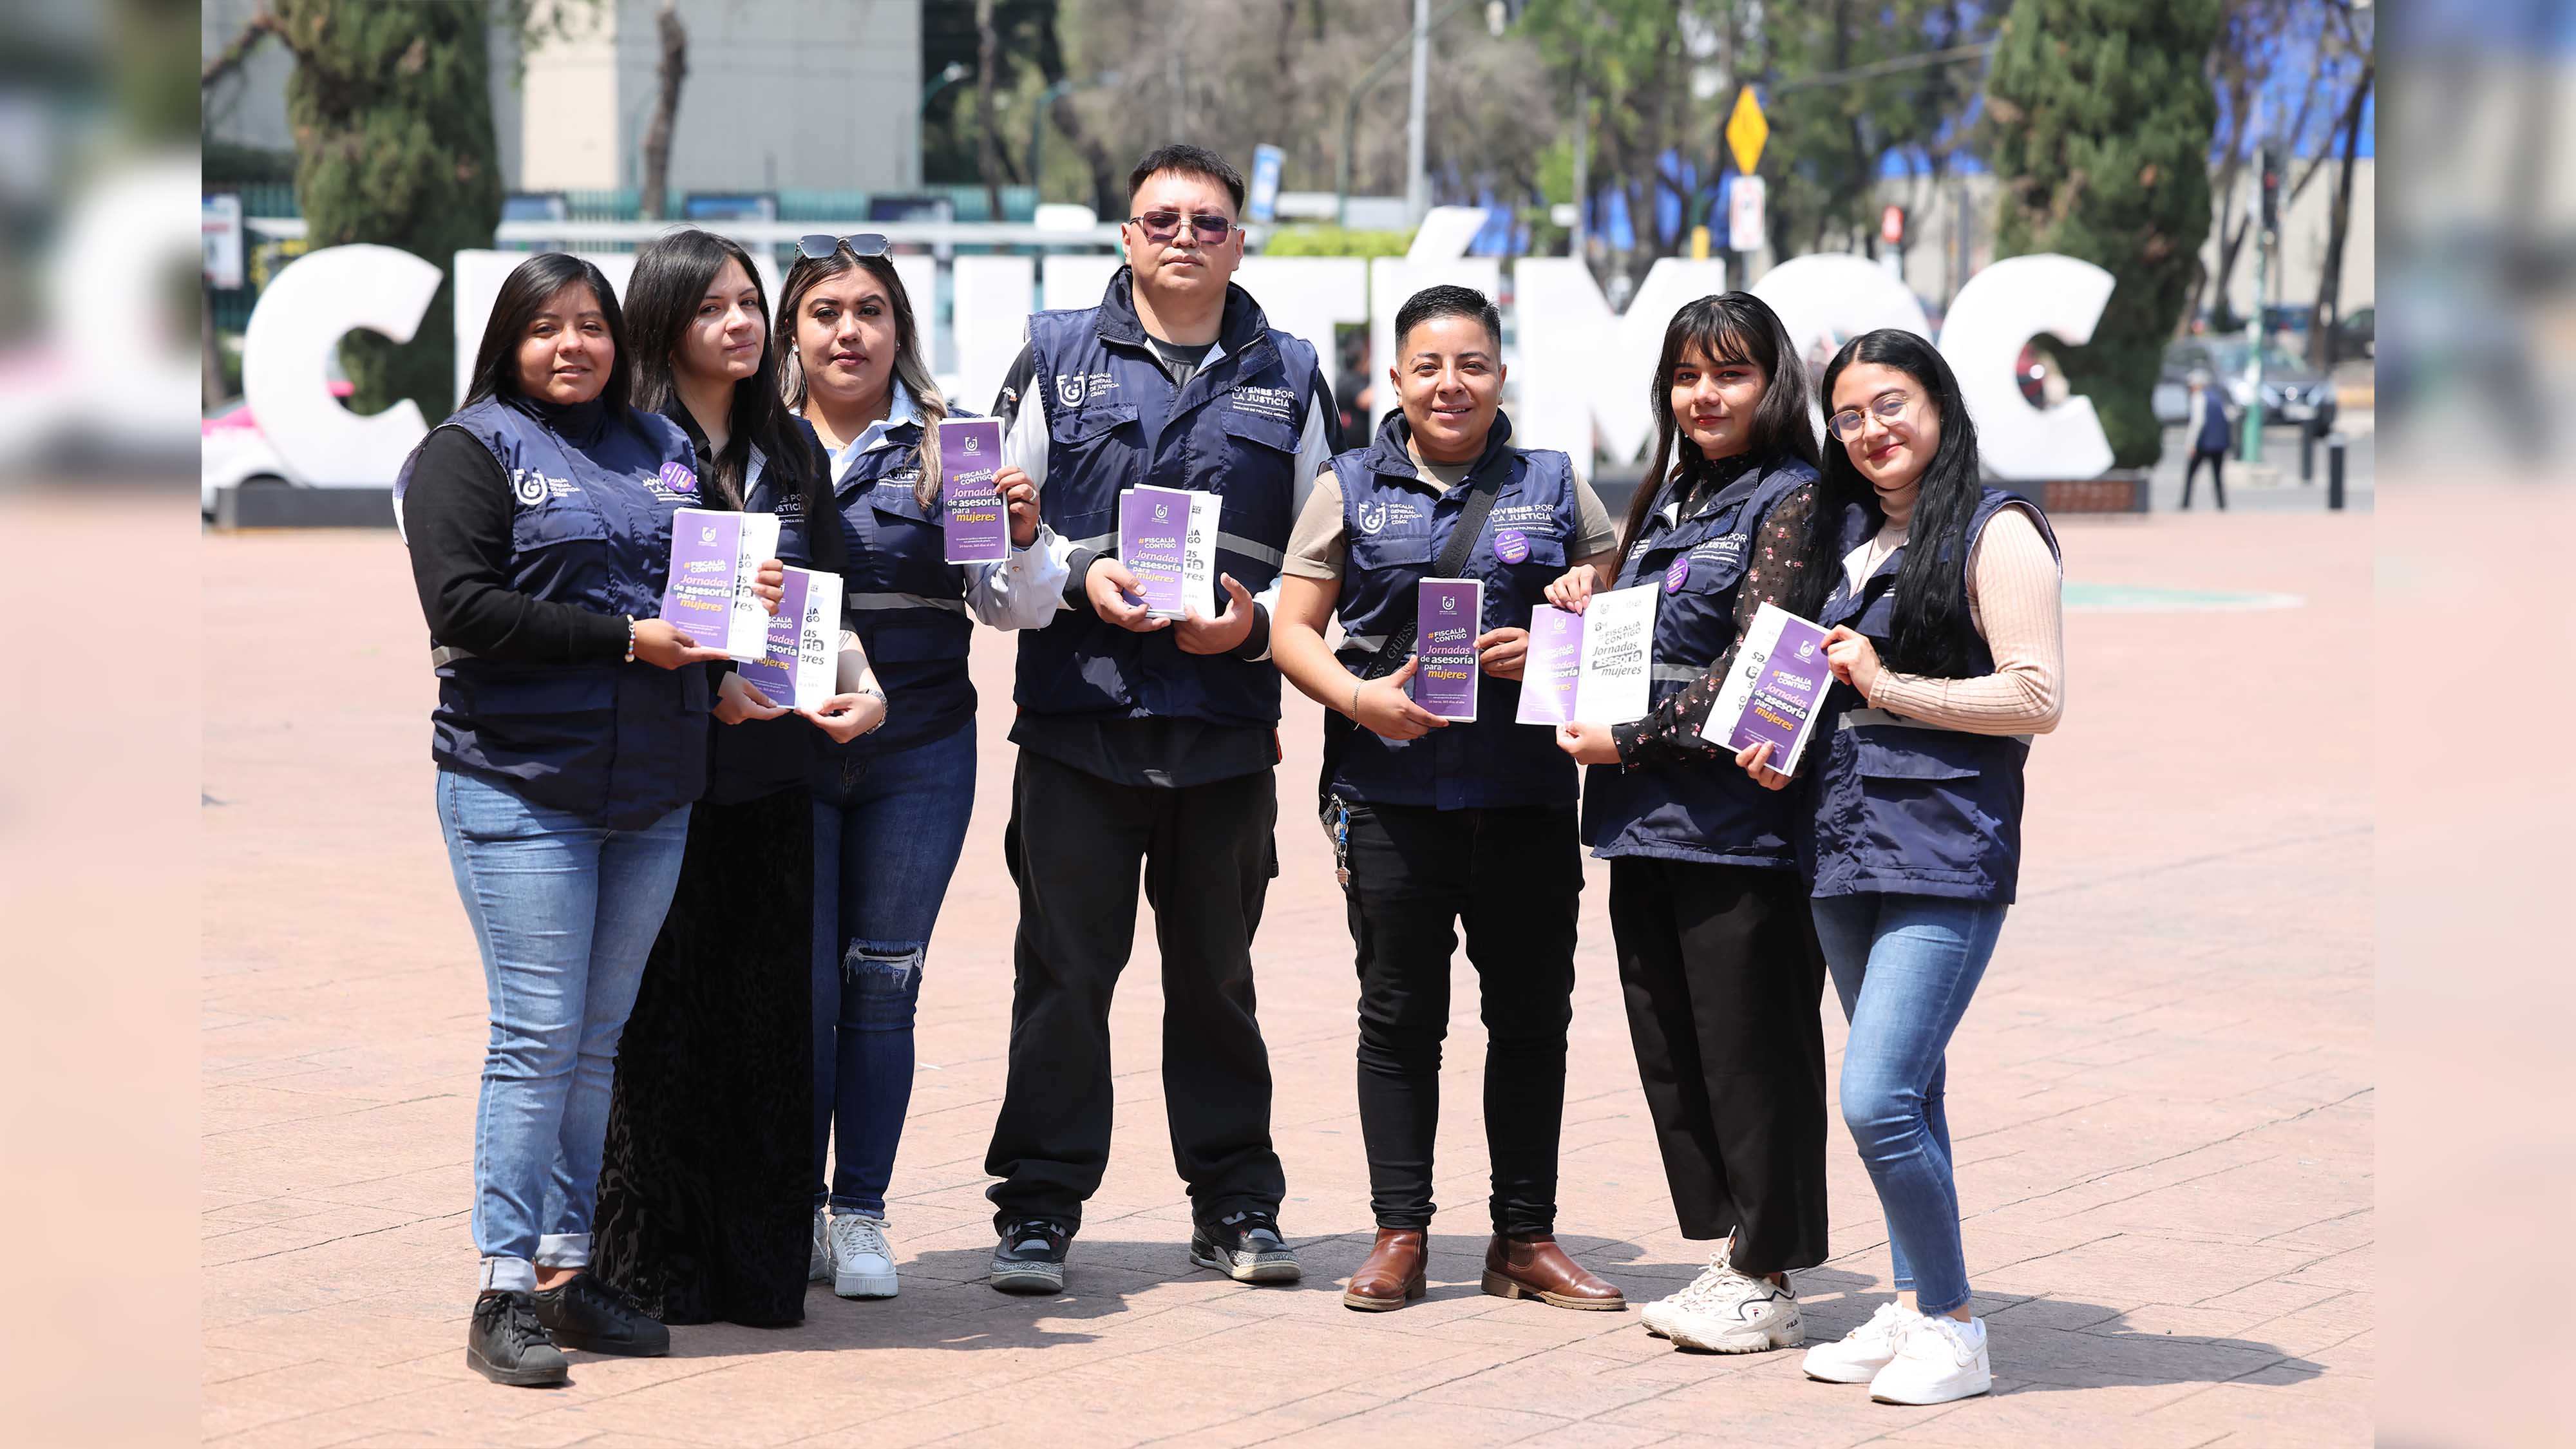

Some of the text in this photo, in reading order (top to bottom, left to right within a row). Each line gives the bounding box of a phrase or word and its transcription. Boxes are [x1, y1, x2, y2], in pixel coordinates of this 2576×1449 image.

[1274, 389, 1294, 399] POR
[1247, 394, 1289, 408] JUSTICIA
[953, 468, 991, 482] #FISCALÍA
[960, 474, 992, 486] CONTIGO
[953, 487, 997, 497] Jornadas
[958, 497, 1001, 507] asesoría
[956, 511, 996, 524] mujeres
[1508, 513, 1552, 521] JUSTICIA
[1728, 533, 1747, 542] POR
[1135, 550, 1179, 563] Jornadas
[683, 559, 726, 569] #FISCALÍA
[690, 565, 726, 573] CONTIGO
[1141, 560, 1182, 573] asesoría
[680, 574, 729, 587] Jornadas
[1136, 573, 1175, 583] mujeres
[685, 585, 732, 598] asesoría
[680, 599, 723, 612] mujeres
[1428, 627, 1466, 639] #FISCALÍA
[1435, 633, 1467, 643] CONTIGO
[1605, 627, 1642, 645] CONTIGO
[766, 645, 797, 656] esoría
[1426, 645, 1471, 654] Jornadas
[1592, 641, 1638, 656] Jornadas
[1431, 655, 1473, 665] asesoría
[1428, 669, 1468, 680] mujeres
[1601, 665, 1642, 677] mujeres
[1772, 670, 1812, 685] #FISCALÍA
[1777, 677, 1812, 692] CONTIGO
[1764, 682, 1808, 708] Jornadas
[1754, 688, 1765, 699] de
[1764, 693, 1807, 720] asesoría
[1754, 697, 1772, 711] para
[1754, 706, 1794, 732] mujeres
[1786, 1319, 1798, 1329] FILA
